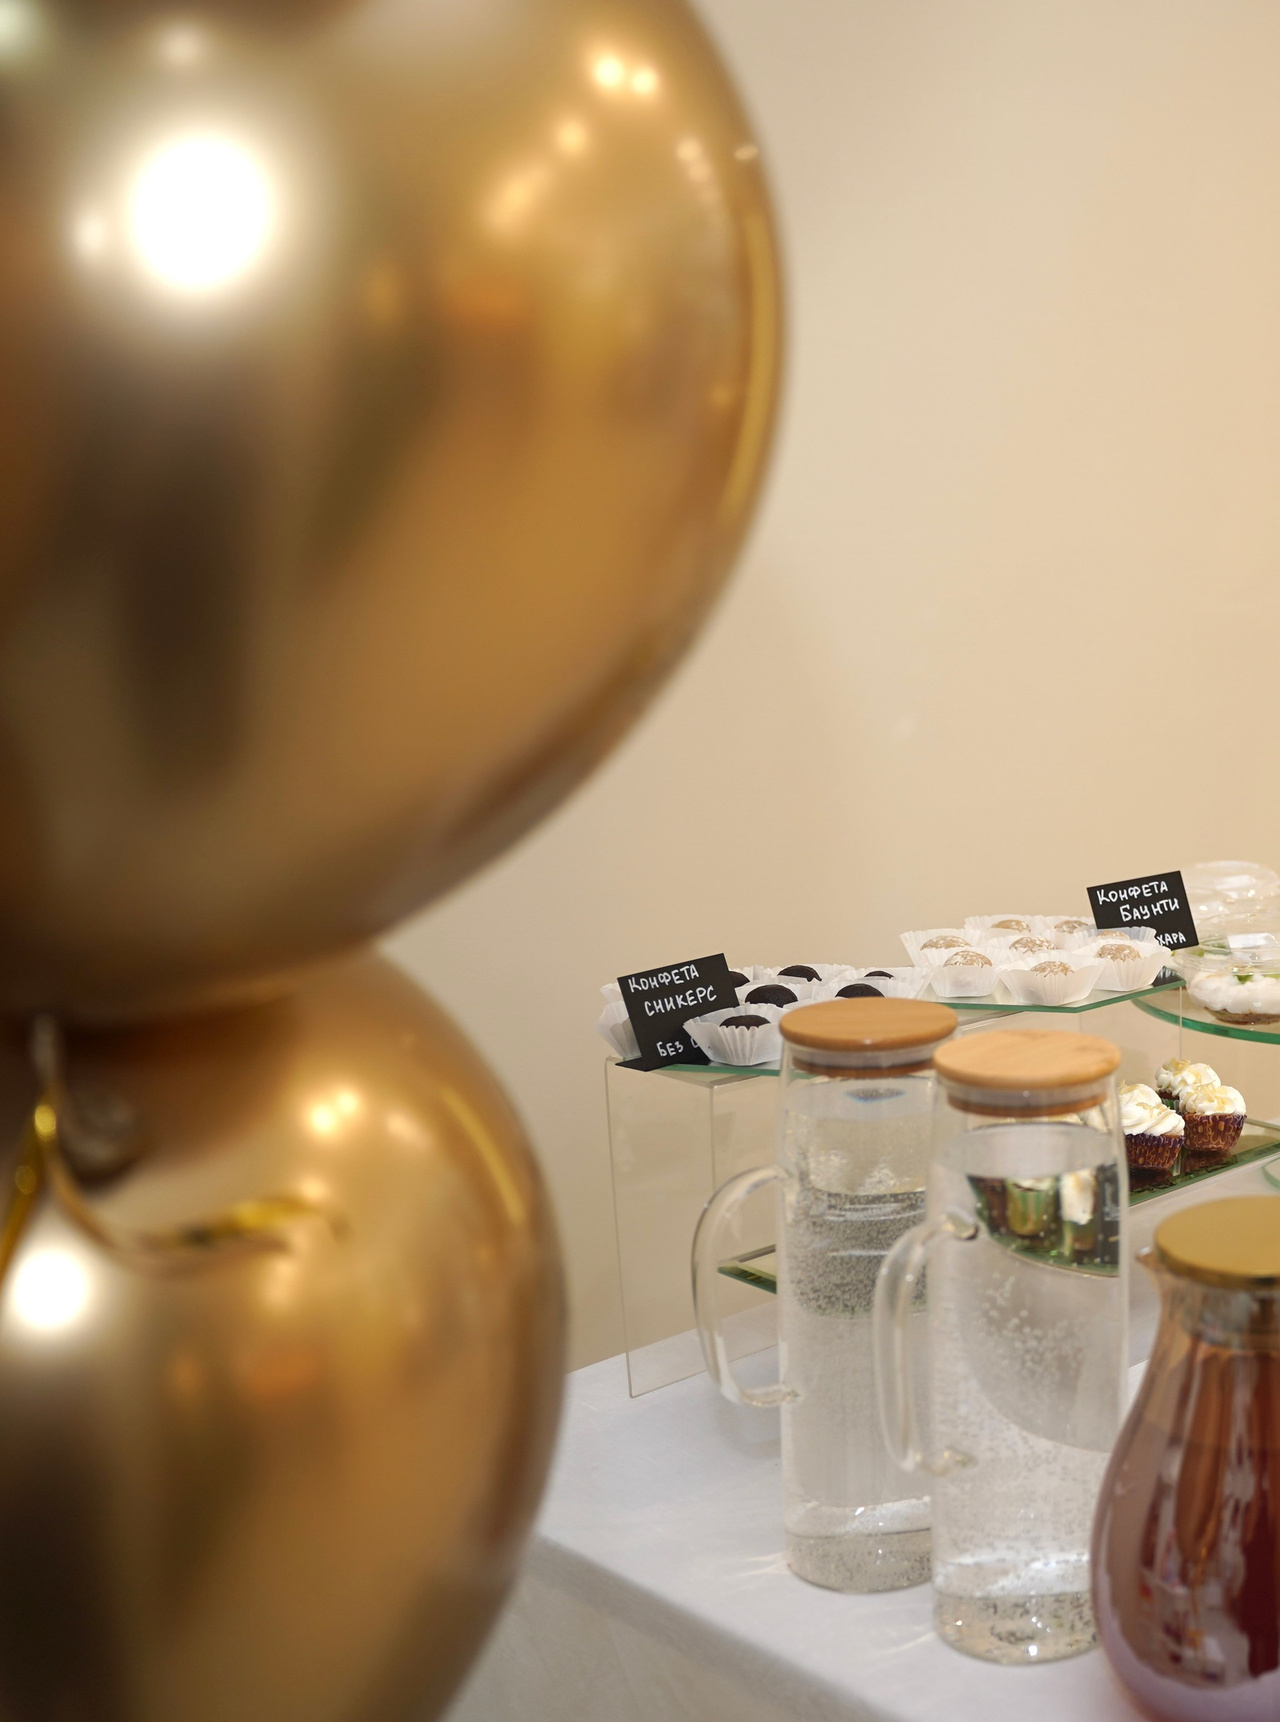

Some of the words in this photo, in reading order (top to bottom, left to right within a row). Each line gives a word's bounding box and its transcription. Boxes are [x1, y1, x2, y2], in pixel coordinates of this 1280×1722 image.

[1096, 880, 1169, 906] КОНФЕТА
[1119, 897, 1181, 922] БАУНТИ
[1156, 931, 1187, 946] ХАРА
[628, 964, 700, 993] КОНФЕТА
[644, 985, 718, 1017] СНИКЕРС
[656, 1040, 684, 1057] БЕЗ
